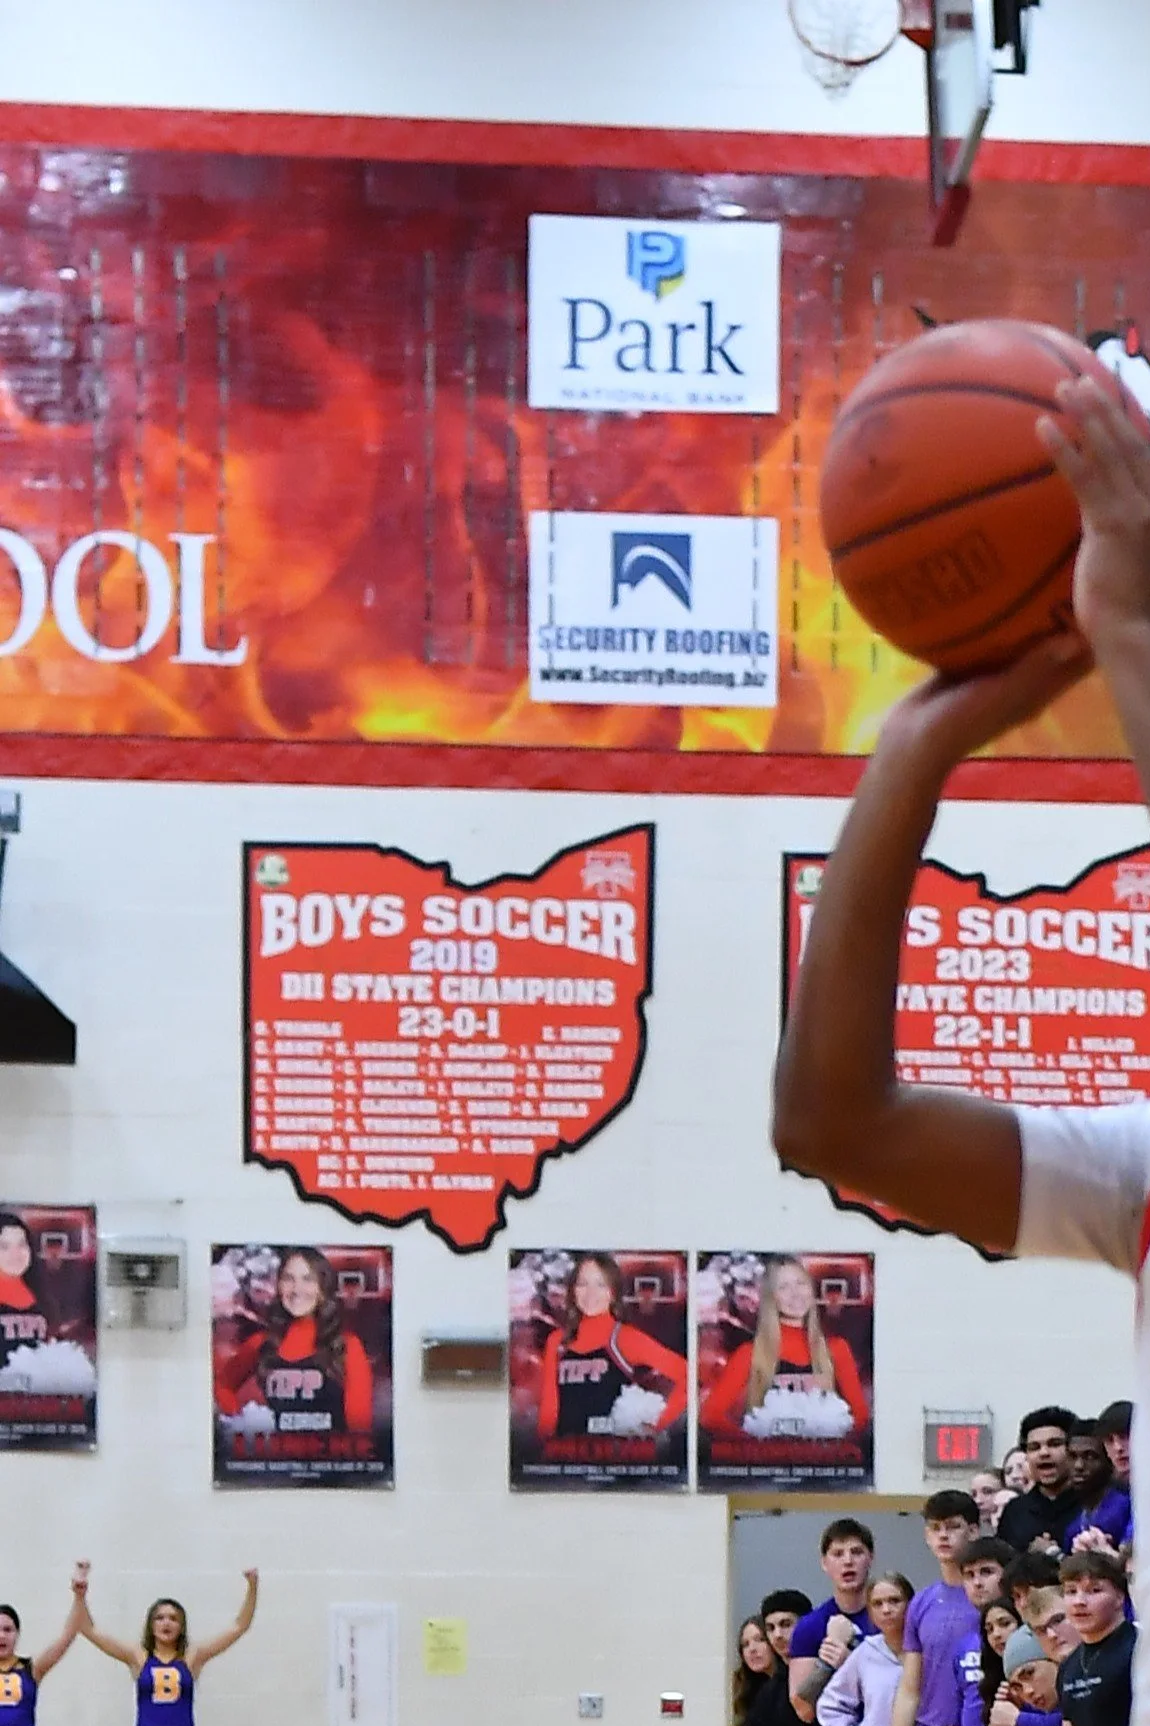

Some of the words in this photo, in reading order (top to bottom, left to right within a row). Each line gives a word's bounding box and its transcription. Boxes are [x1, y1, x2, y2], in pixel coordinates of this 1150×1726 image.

[563, 297, 744, 375] Park
[539, 626, 658, 652] SECURITY
[665, 628, 770, 655] ROOFING
[260, 892, 406, 958] BOYS
[422, 895, 638, 966] SOCCER
[409, 937, 498, 973] 2019
[936, 947, 1031, 982] 2023
[331, 972, 434, 1003] STATE
[438, 975, 616, 1006] CHAMPIONS
[896, 985, 968, 1013] TATE
[973, 986, 1147, 1017] CHAMPIONS
[397, 1006, 500, 1039] 23-0-1
[933, 1014, 1032, 1048] 22-1-1
[936, 1425, 980, 1462] EXIT
[151, 1666, 181, 1704] B
